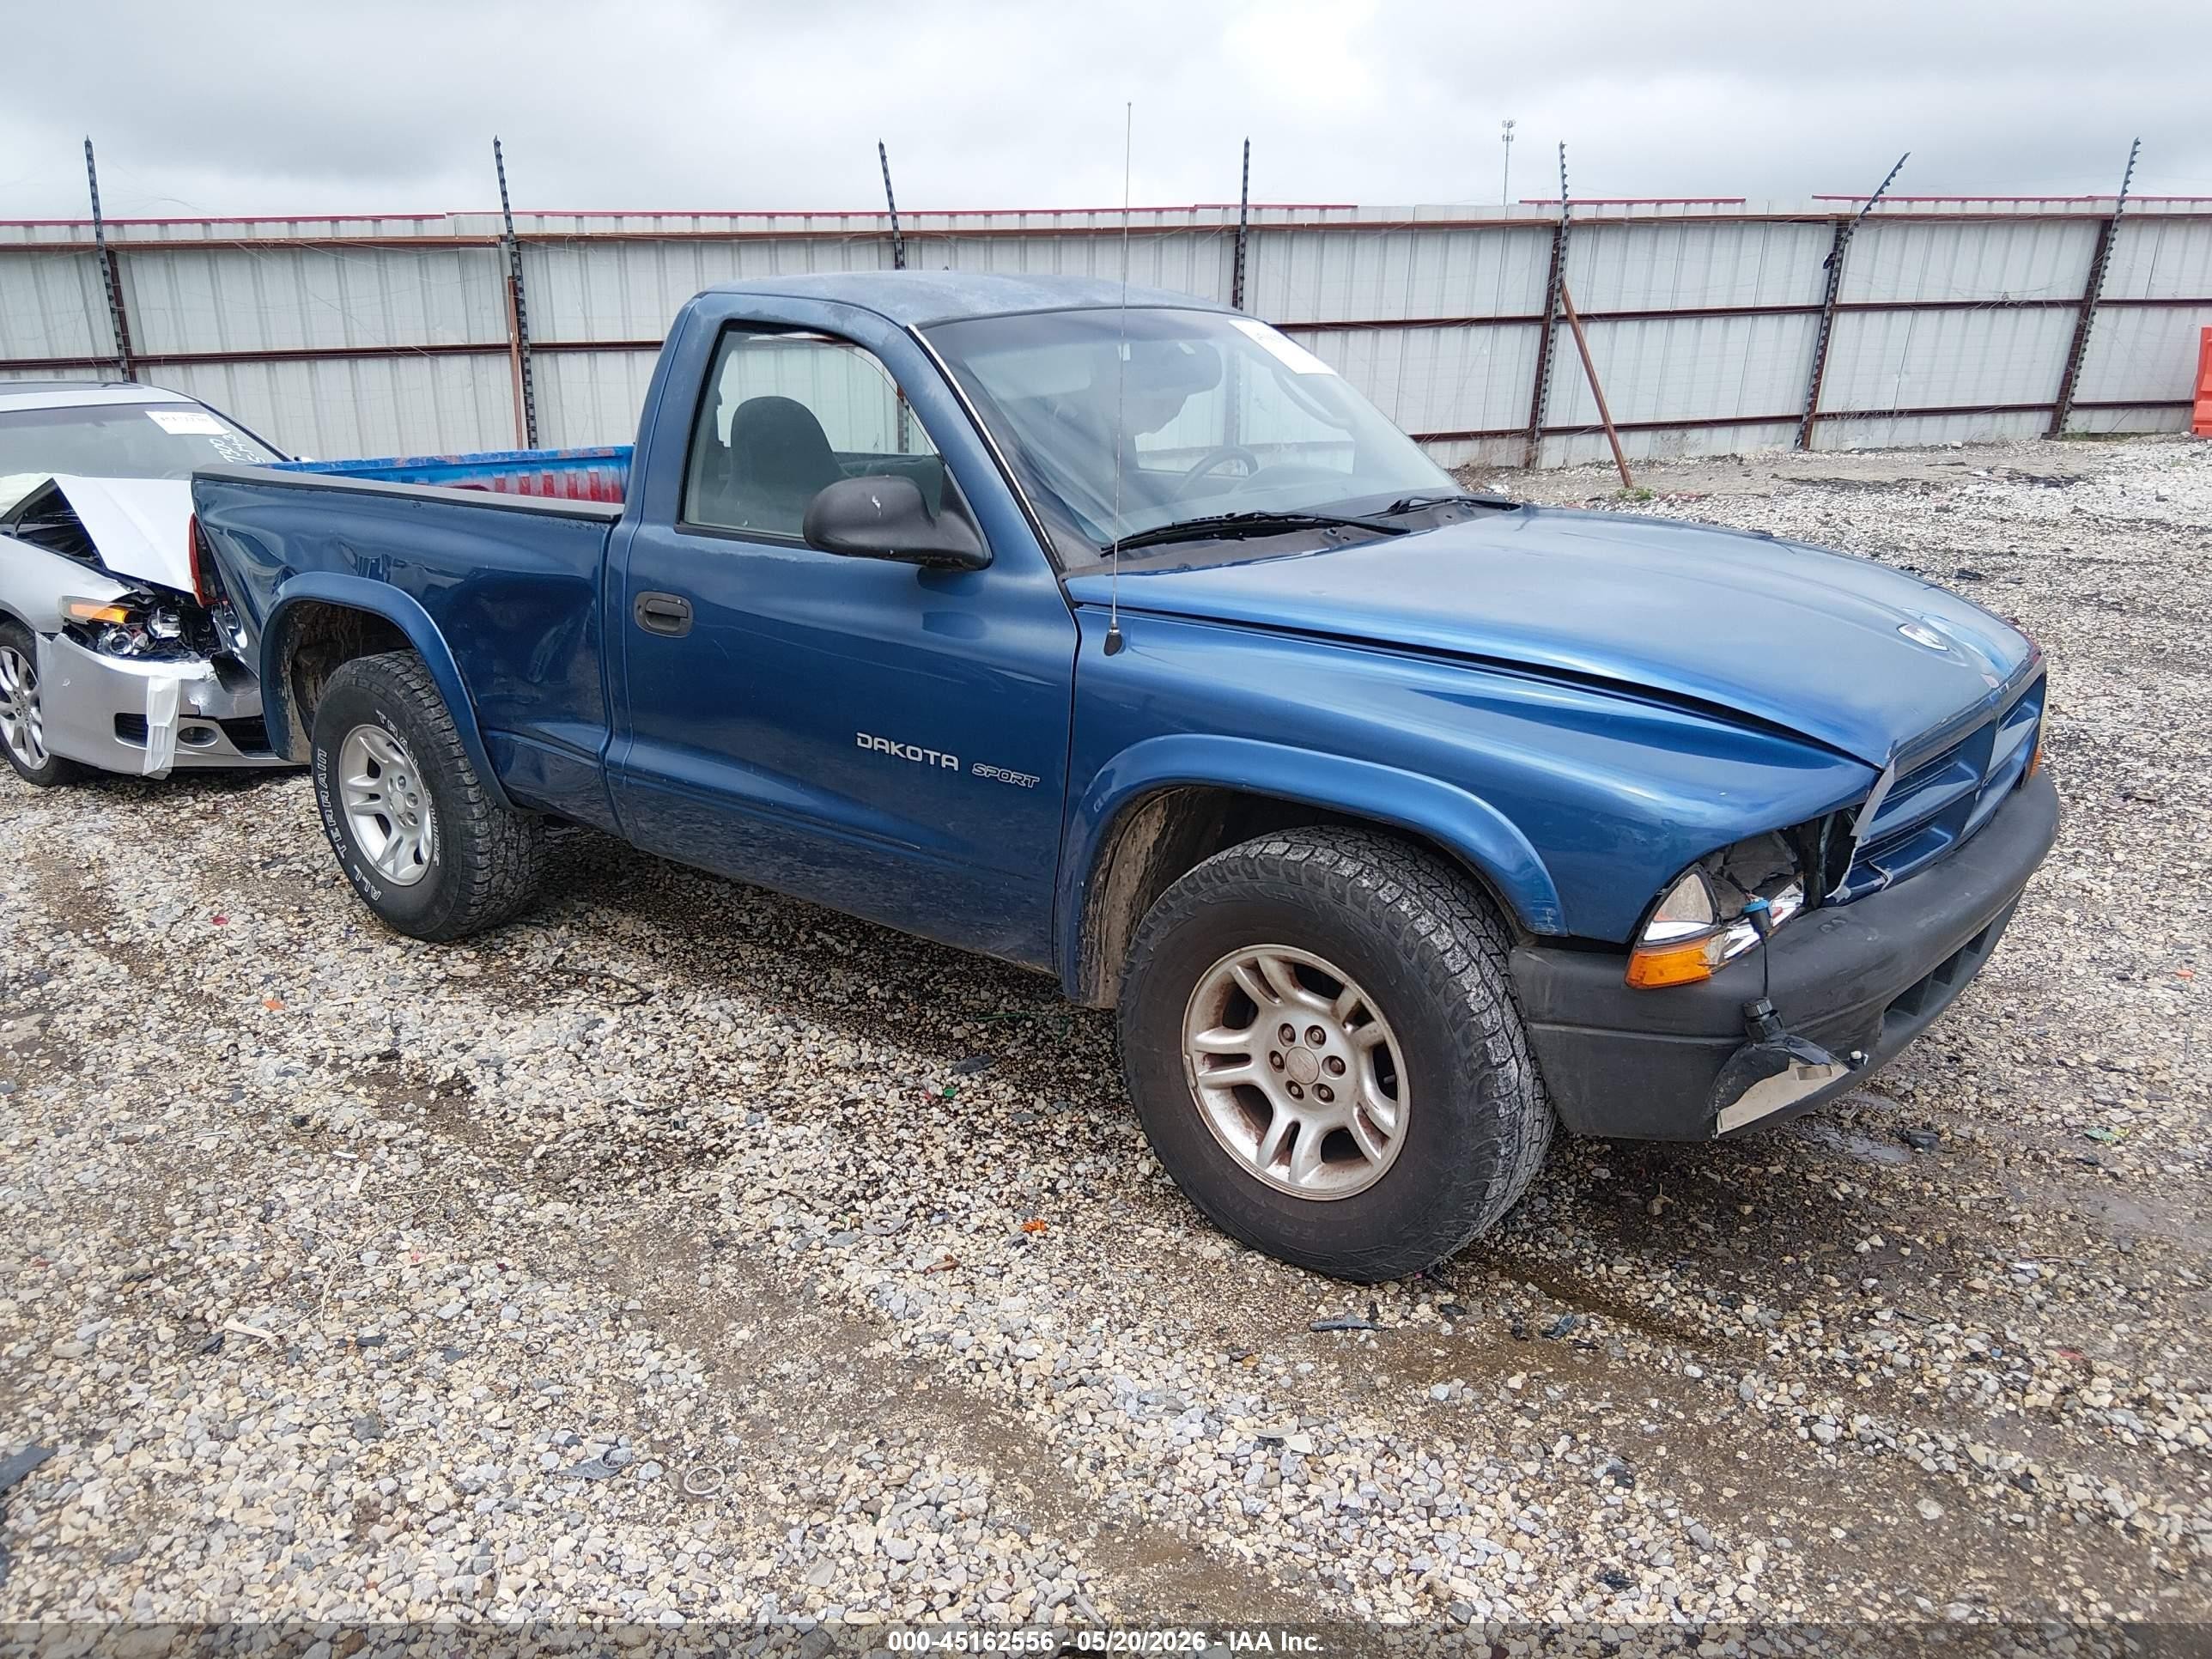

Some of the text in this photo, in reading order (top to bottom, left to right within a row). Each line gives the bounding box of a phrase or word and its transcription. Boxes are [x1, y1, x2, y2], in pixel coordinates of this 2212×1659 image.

[856, 732, 1040, 789] DAKOTA SPORT
[317, 748, 381, 901] ALL TERRAIN
